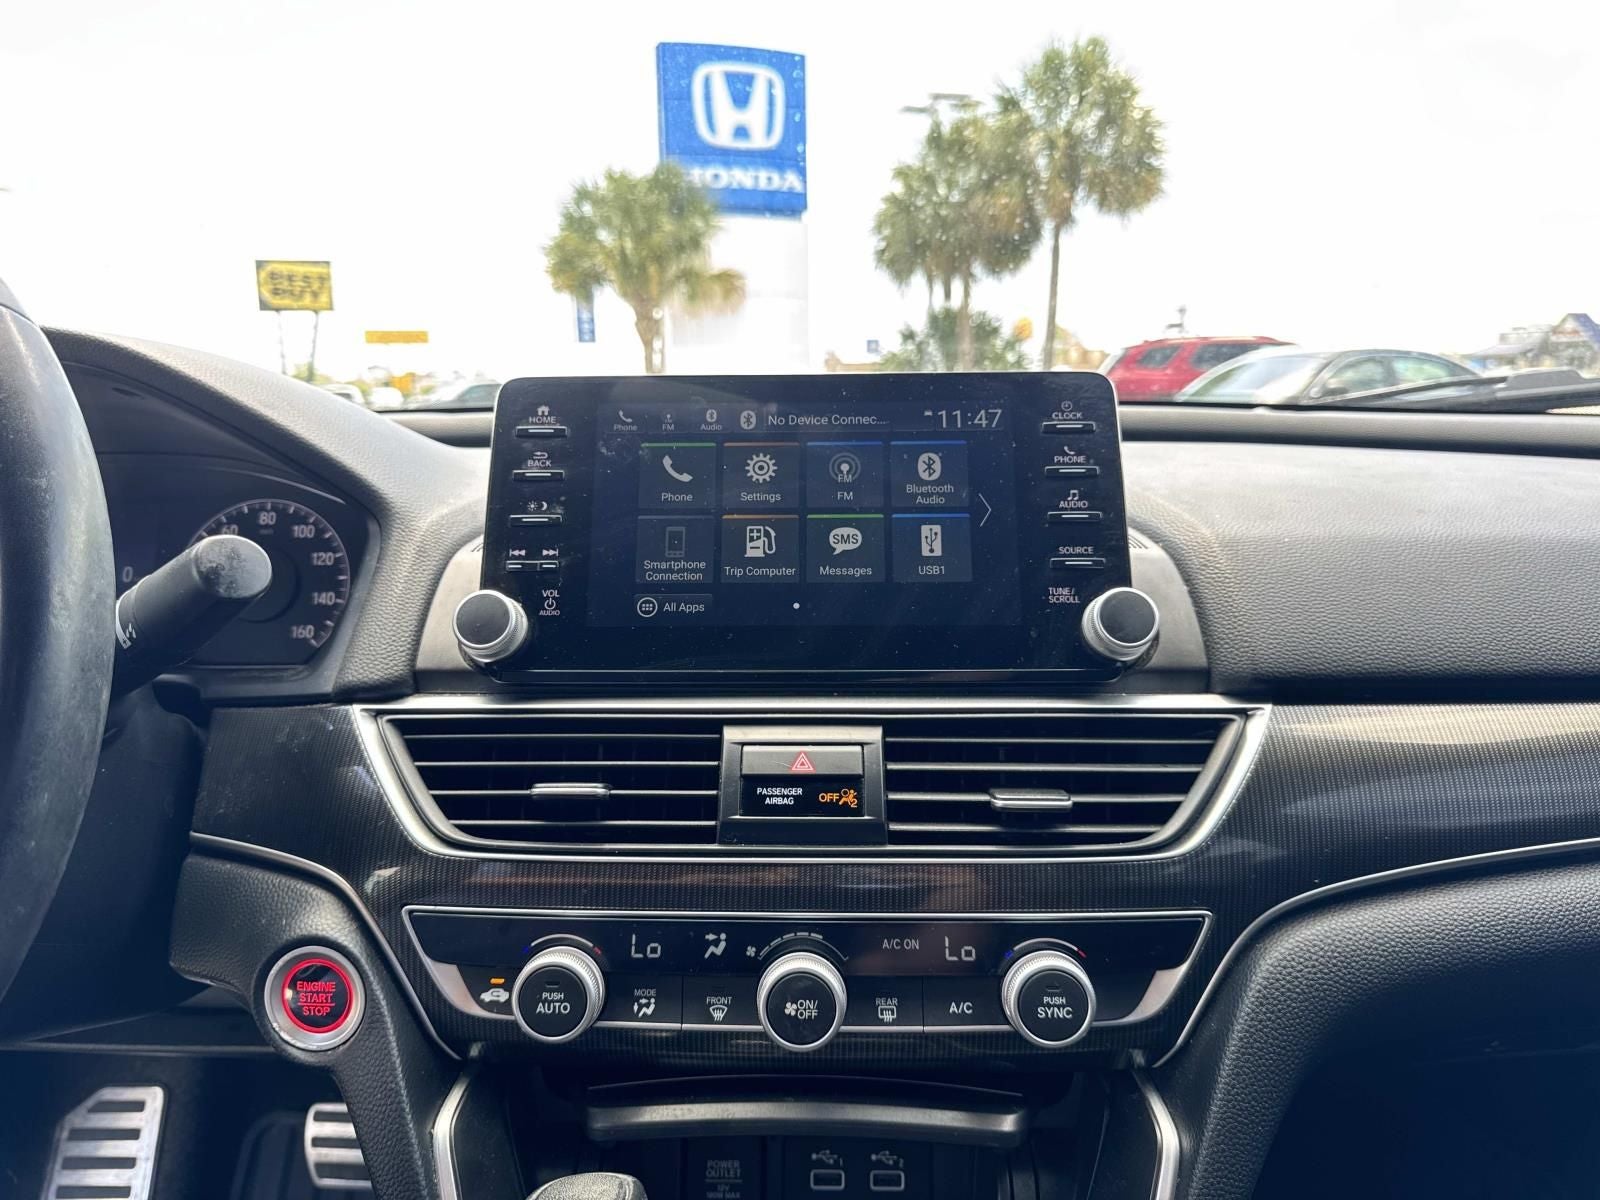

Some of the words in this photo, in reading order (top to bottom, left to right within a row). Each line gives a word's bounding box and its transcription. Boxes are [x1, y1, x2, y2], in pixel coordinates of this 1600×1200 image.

[529, 416, 556, 424] HOME
[768, 415, 786, 425] No
[788, 415, 829, 425] Device
[937, 408, 1002, 429] 11:47
[1052, 411, 1083, 420] CLOCK
[613, 423, 638, 432] Phone
[662, 423, 675, 431] FM
[700, 423, 723, 431] Audio
[527, 459, 552, 468] BACK
[1054, 455, 1086, 464] PHONE
[906, 484, 954, 494] Bluetooth
[661, 492, 693, 502] Phone
[740, 491, 782, 503] Settings
[837, 491, 854, 500] FM
[916, 495, 945, 504] Audio
[1058, 500, 1088, 508] AUDIO
[259, 511, 277, 525] 80
[292, 525, 316, 539] 100
[832, 533, 859, 545] SMS
[1058, 546, 1094, 555] SOURCE
[311, 552, 335, 566] 120
[643, 559, 706, 571] Smartphone
[918, 565, 945, 575] USB1
[645, 571, 703, 581] Connection
[724, 566, 743, 577] Trip
[746, 566, 796, 578] Computer
[819, 565, 872, 577] Messages
[542, 589, 560, 598] VOL
[1048, 587, 1075, 596] TUNE/
[312, 591, 335, 605] 140
[1048, 595, 1080, 604] SCROLL
[663, 602, 677, 611] All
[679, 602, 705, 613] Apps
[291, 624, 315, 639] 160
[756, 787, 803, 795] PASSENGER
[764, 797, 794, 805] AIRBAG
[818, 793, 839, 803] OFF
[631, 933, 661, 958] Lo
[882, 938, 902, 950] A/C
[903, 938, 920, 950] ON
[944, 935, 976, 961] Lo
[296, 981, 337, 992] ENGINE
[542, 991, 564, 1000] PUSH
[634, 988, 657, 996] MODE
[299, 993, 333, 1003] START
[706, 996, 732, 1005] FRONT
[875, 997, 898, 1006] REAR
[1043, 996, 1066, 1005] PUSH
[535, 1002, 571, 1014] AUTO
[797, 999, 818, 1010] ON/
[949, 1002, 973, 1014] A/C
[302, 1006, 331, 1016] STOP
[797, 1009, 818, 1020] OFF
[1037, 1006, 1073, 1019] SYNC
[707, 1159, 740, 1168] POWER
[705, 1168, 741, 1178] OUTLET
